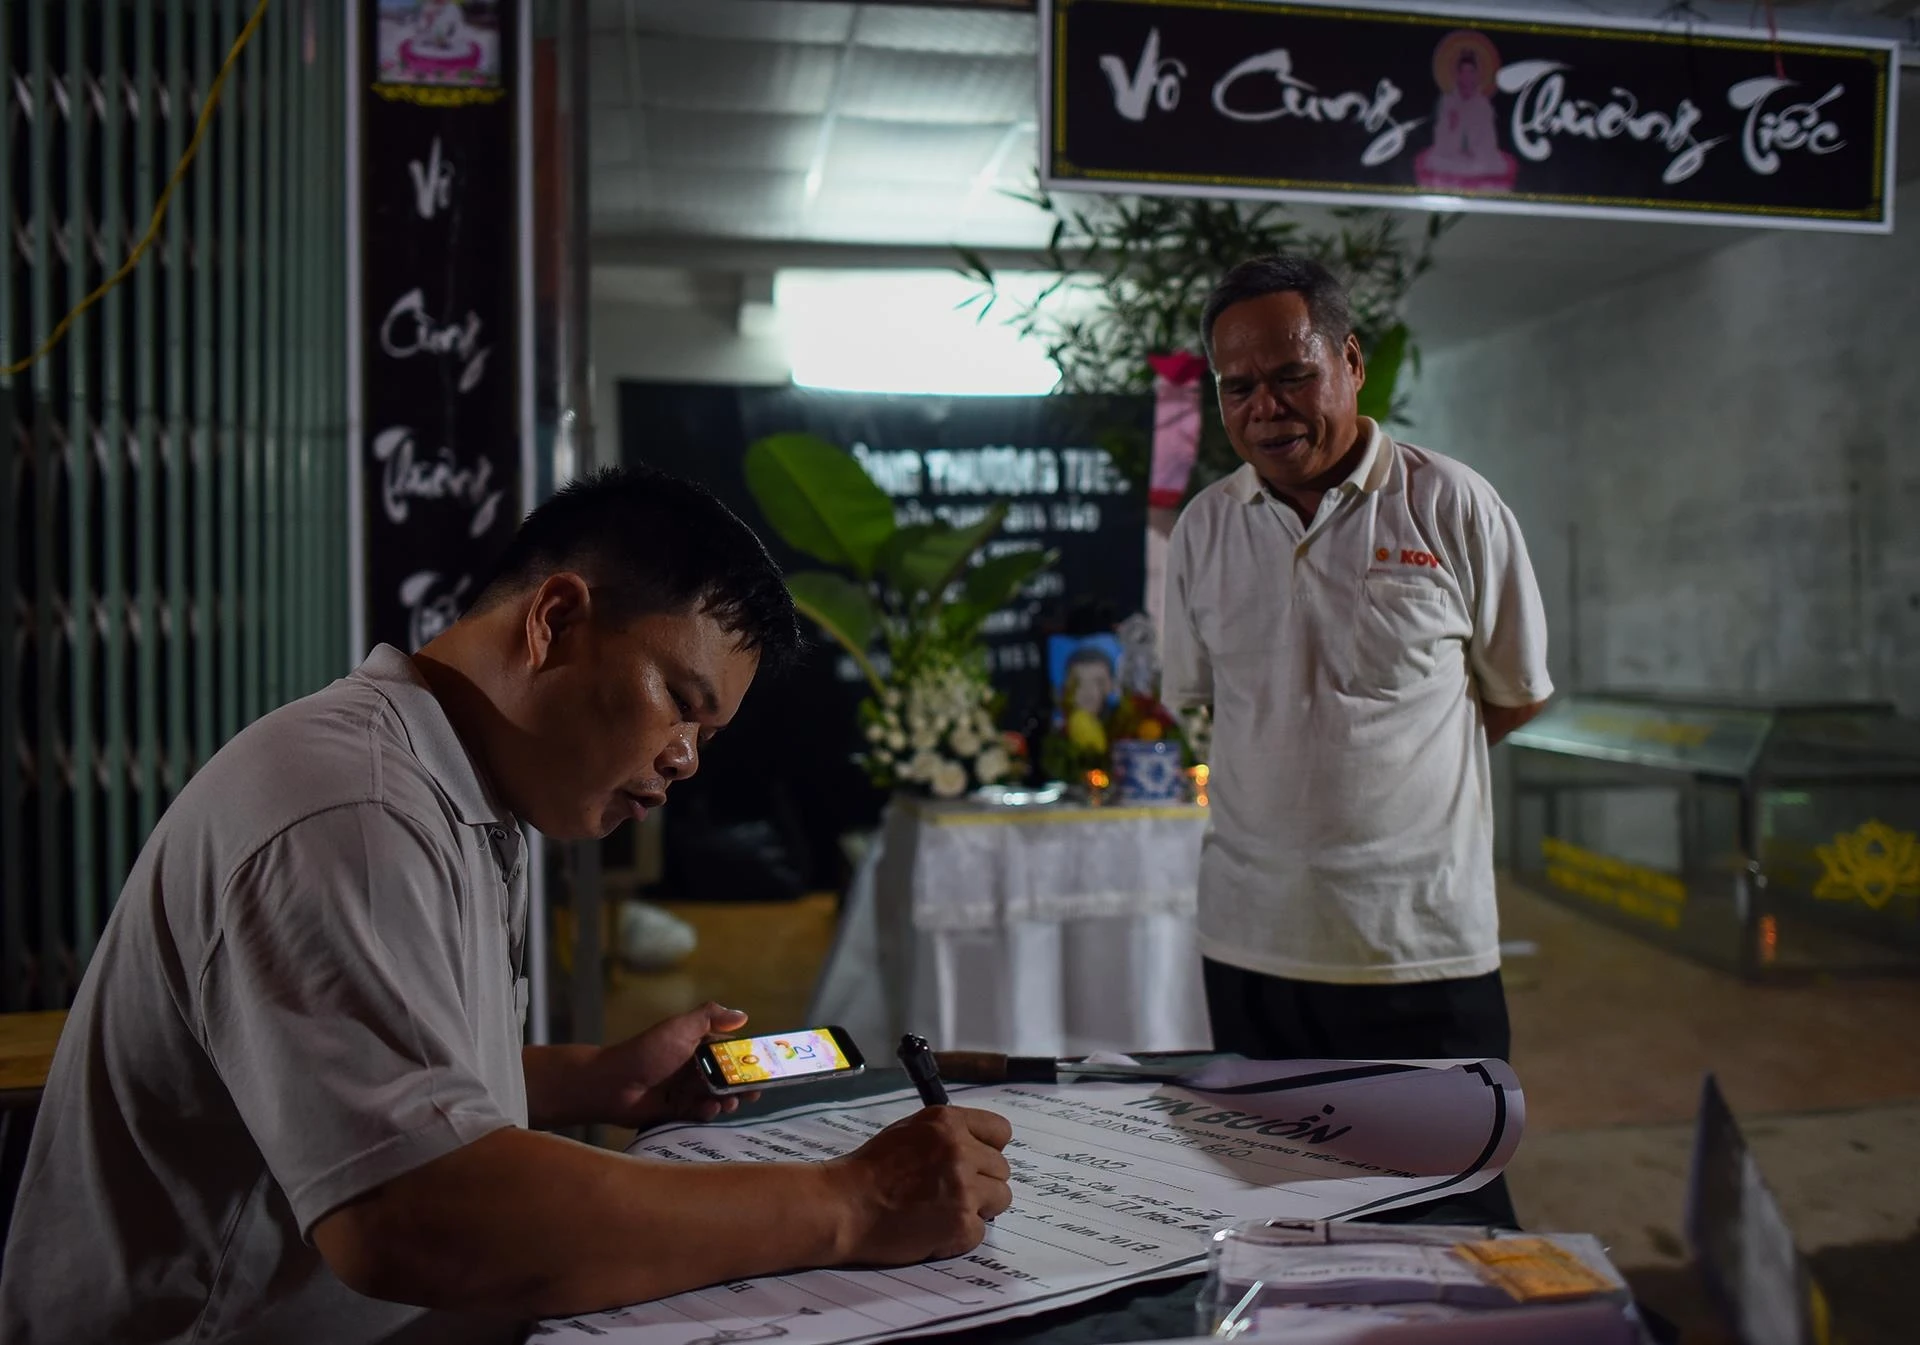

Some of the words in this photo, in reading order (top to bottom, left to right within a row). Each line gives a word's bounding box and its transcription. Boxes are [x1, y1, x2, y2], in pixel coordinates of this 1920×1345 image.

[1100, 26, 1188, 121] Vô
[1728, 76, 1849, 176] Tiếc
[1122, 1095, 1211, 1117] TIN
[1193, 1104, 1353, 1144] BUỒN
[962, 1254, 1007, 1272] NĂM
